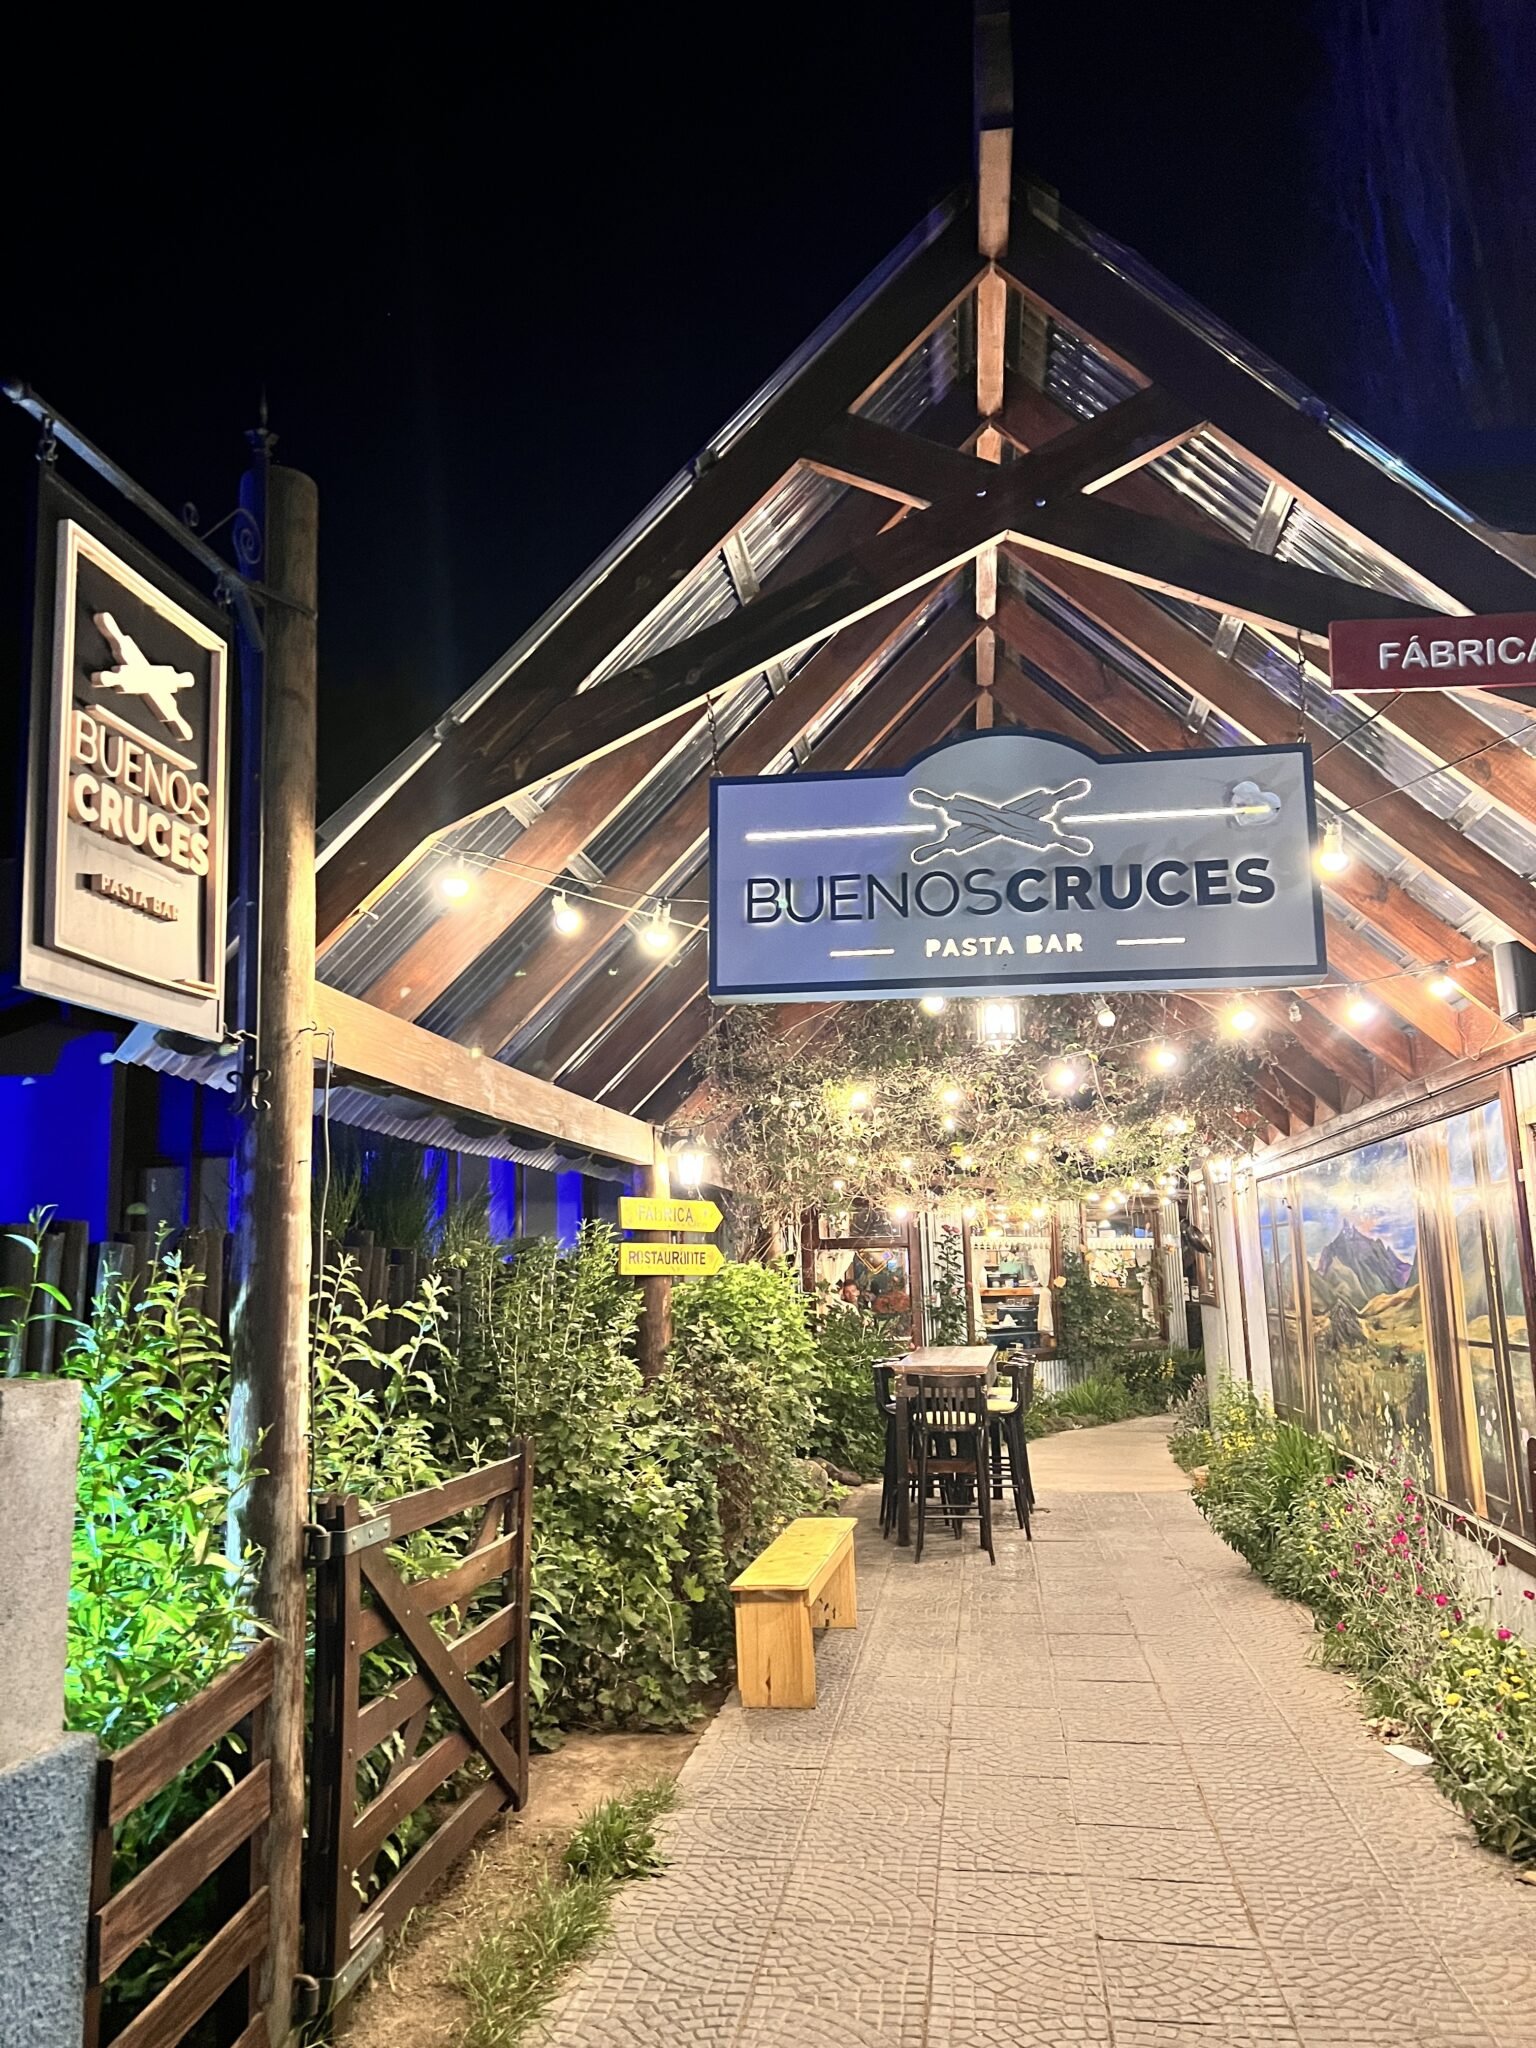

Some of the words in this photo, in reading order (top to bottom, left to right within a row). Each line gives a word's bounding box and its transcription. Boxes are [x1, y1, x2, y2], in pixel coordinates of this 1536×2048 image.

[74, 709, 211, 826] BUENOS
[72, 772, 210, 876] CRUCES
[101, 873, 149, 909] PASTA
[925, 936, 1015, 958] PASTA
[1025, 933, 1084, 954] BAR
